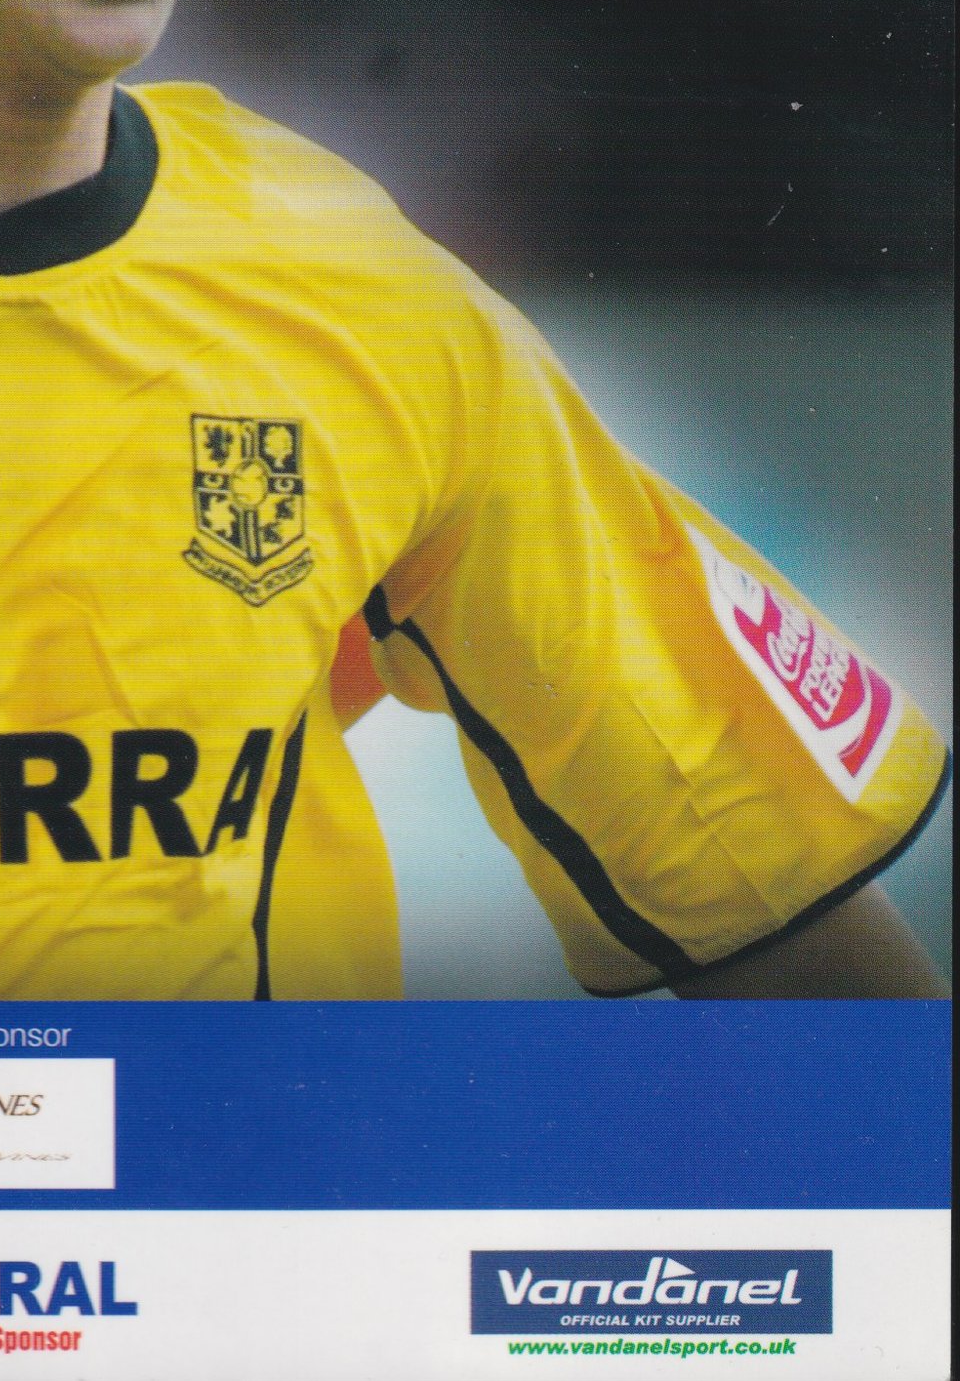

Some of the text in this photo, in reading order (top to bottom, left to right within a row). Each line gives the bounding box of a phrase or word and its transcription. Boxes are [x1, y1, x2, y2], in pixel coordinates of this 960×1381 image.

[498, 1256, 802, 1305] Vandanel
[560, 1314, 741, 1327] OFFICIAL KIT SUPPLIER
[508, 1338, 797, 1359] www.vandanelsport.co.uk
